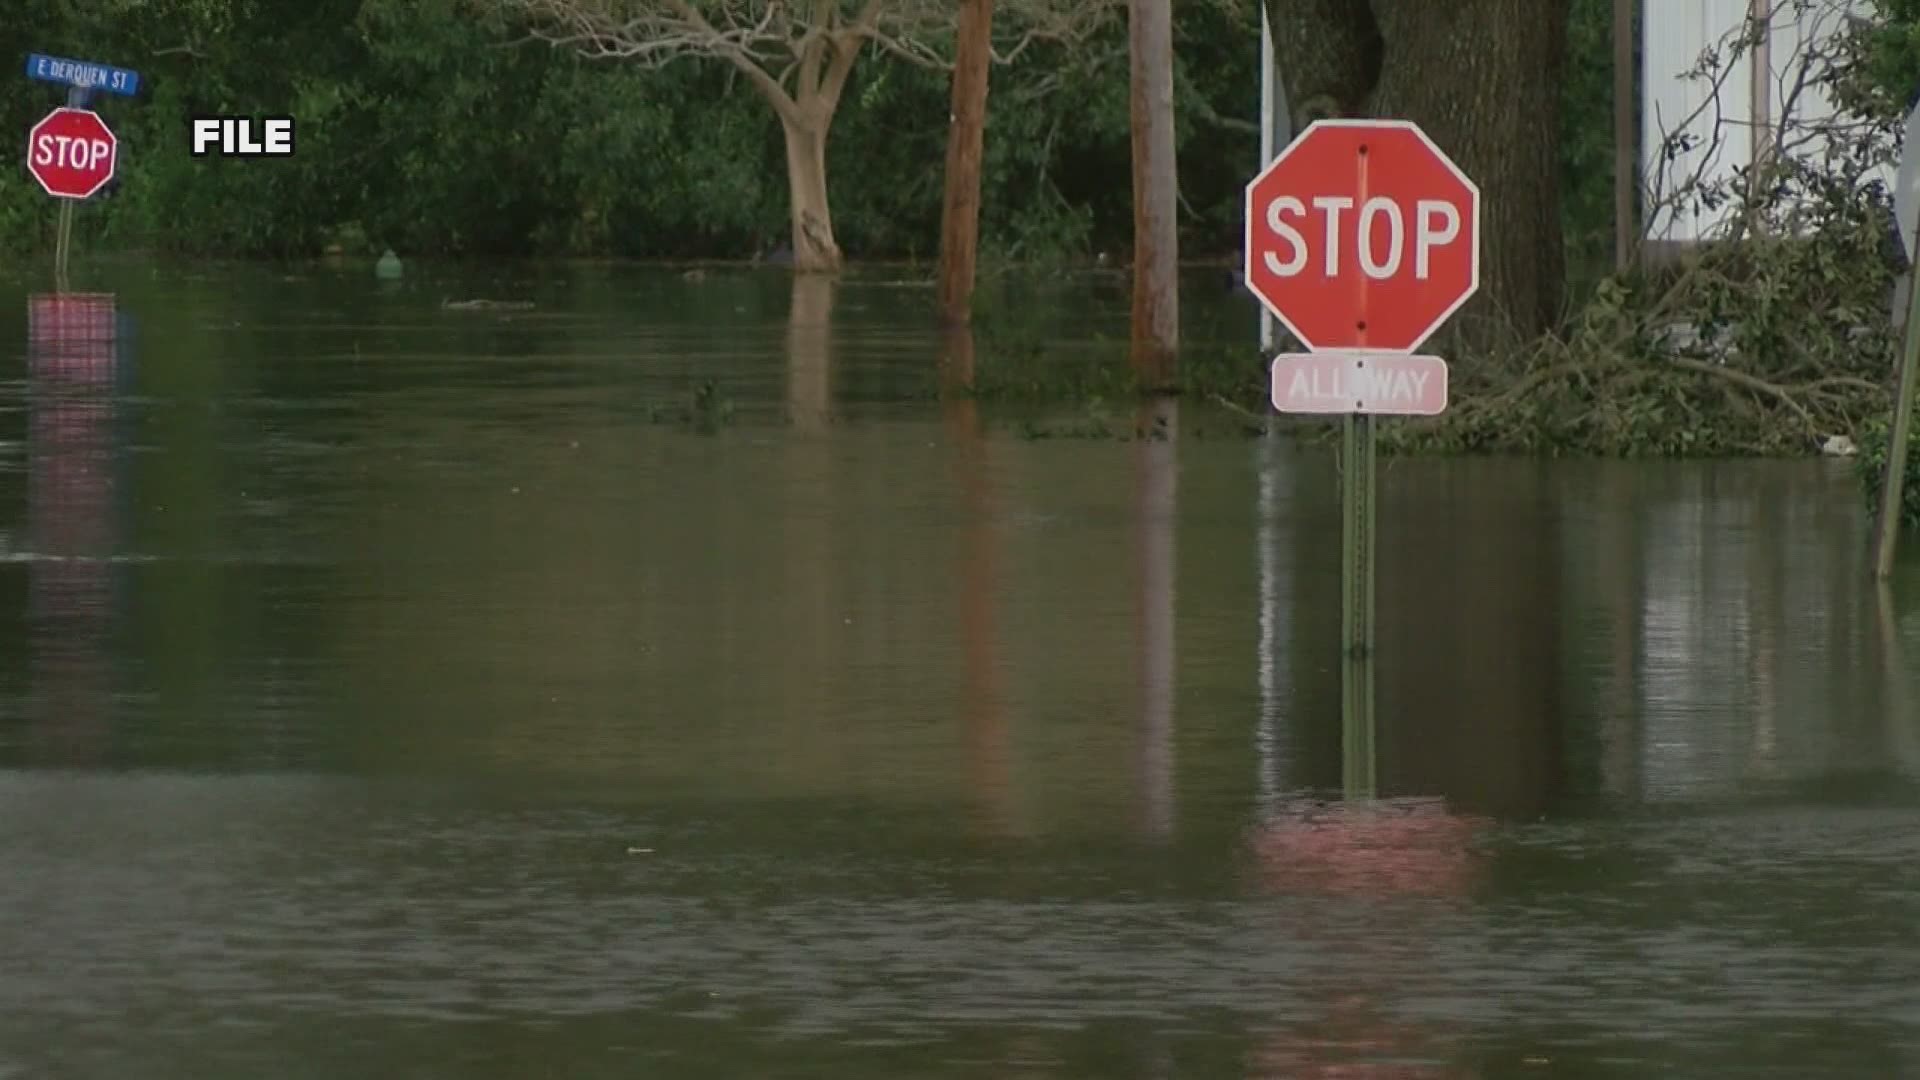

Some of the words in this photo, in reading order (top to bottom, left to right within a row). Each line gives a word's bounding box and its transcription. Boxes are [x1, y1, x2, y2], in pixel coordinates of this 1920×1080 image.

[37, 59, 46, 75] E
[111, 71, 128, 89] ST
[35, 134, 109, 170] STOP
[1263, 196, 1460, 279] STOP
[1288, 368, 1346, 401] ALL
[1364, 370, 1429, 404] WAY
